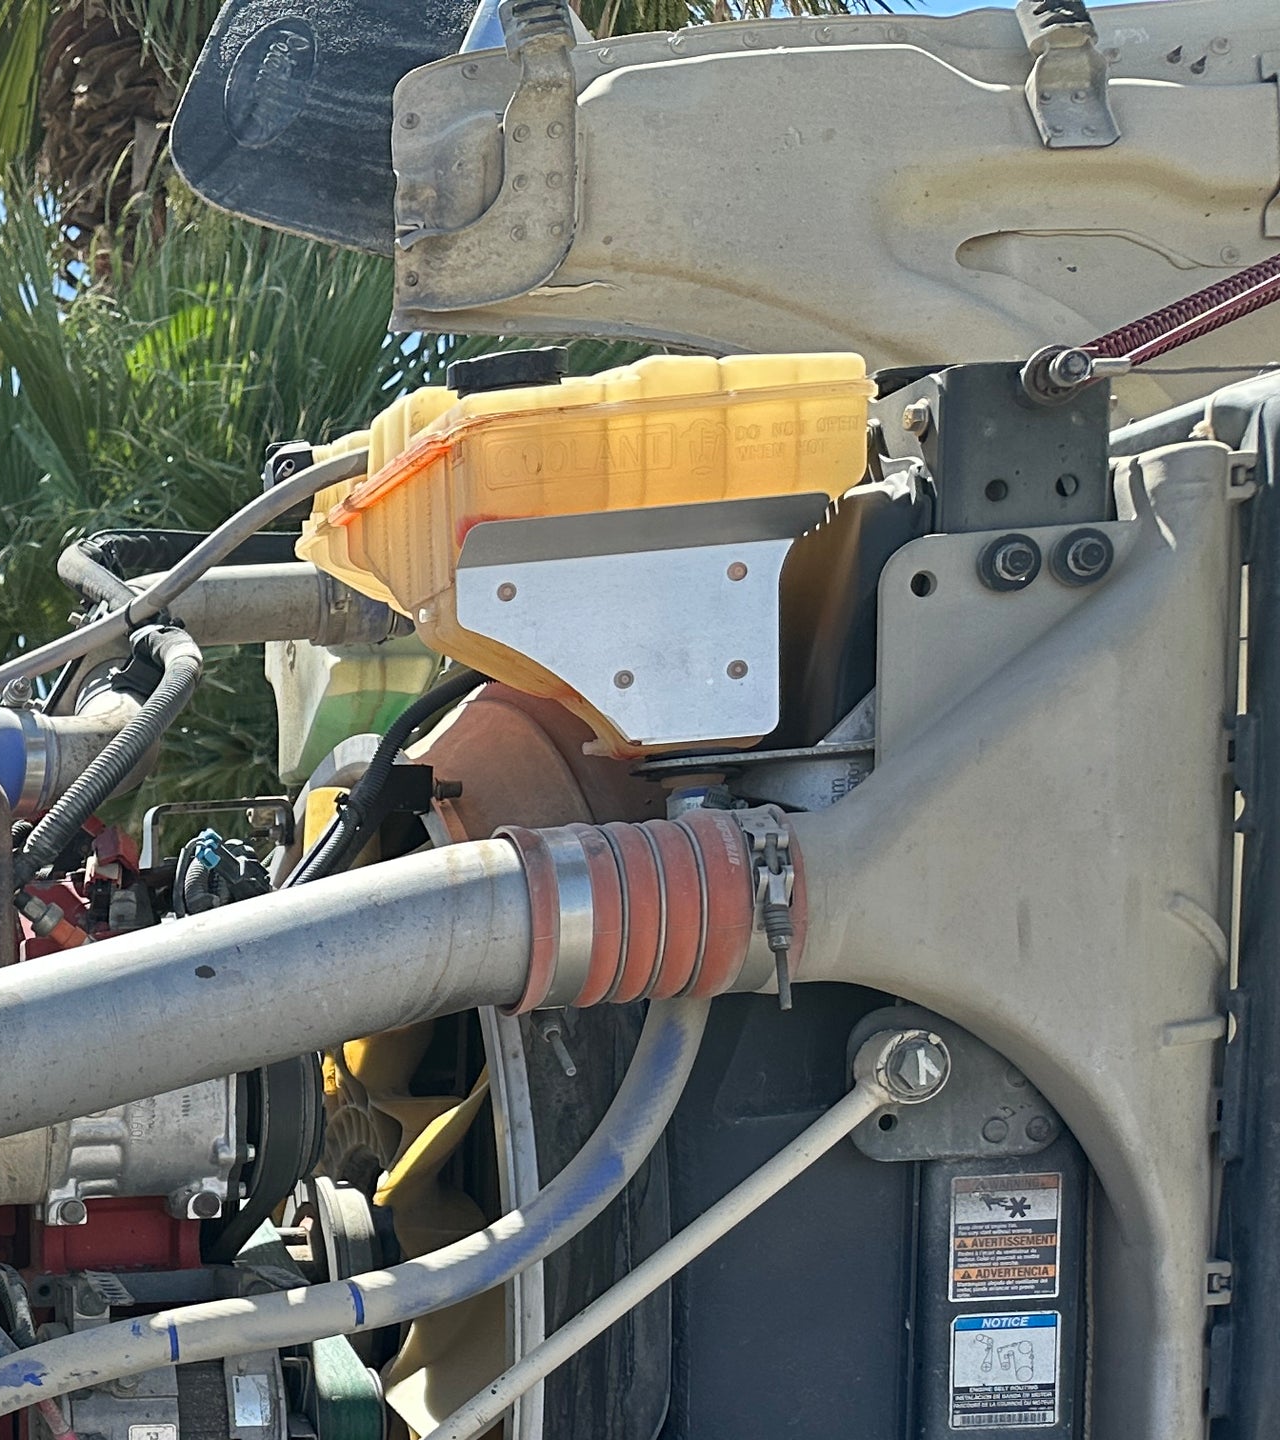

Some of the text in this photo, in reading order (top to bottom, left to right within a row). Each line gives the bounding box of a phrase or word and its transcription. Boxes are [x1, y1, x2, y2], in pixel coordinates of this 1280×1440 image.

[735, 415, 860, 441] DO NOT OPEN
[493, 432, 666, 479] COOLANT
[734, 437, 827, 461] WHEN HOT
[991, 1178, 1039, 1191] WARNING
[971, 1235, 1054, 1248] AVERTISSEMENT
[975, 1266, 1049, 1279] ADVERTENCIA
[982, 1317, 1029, 1328] NOTICE
